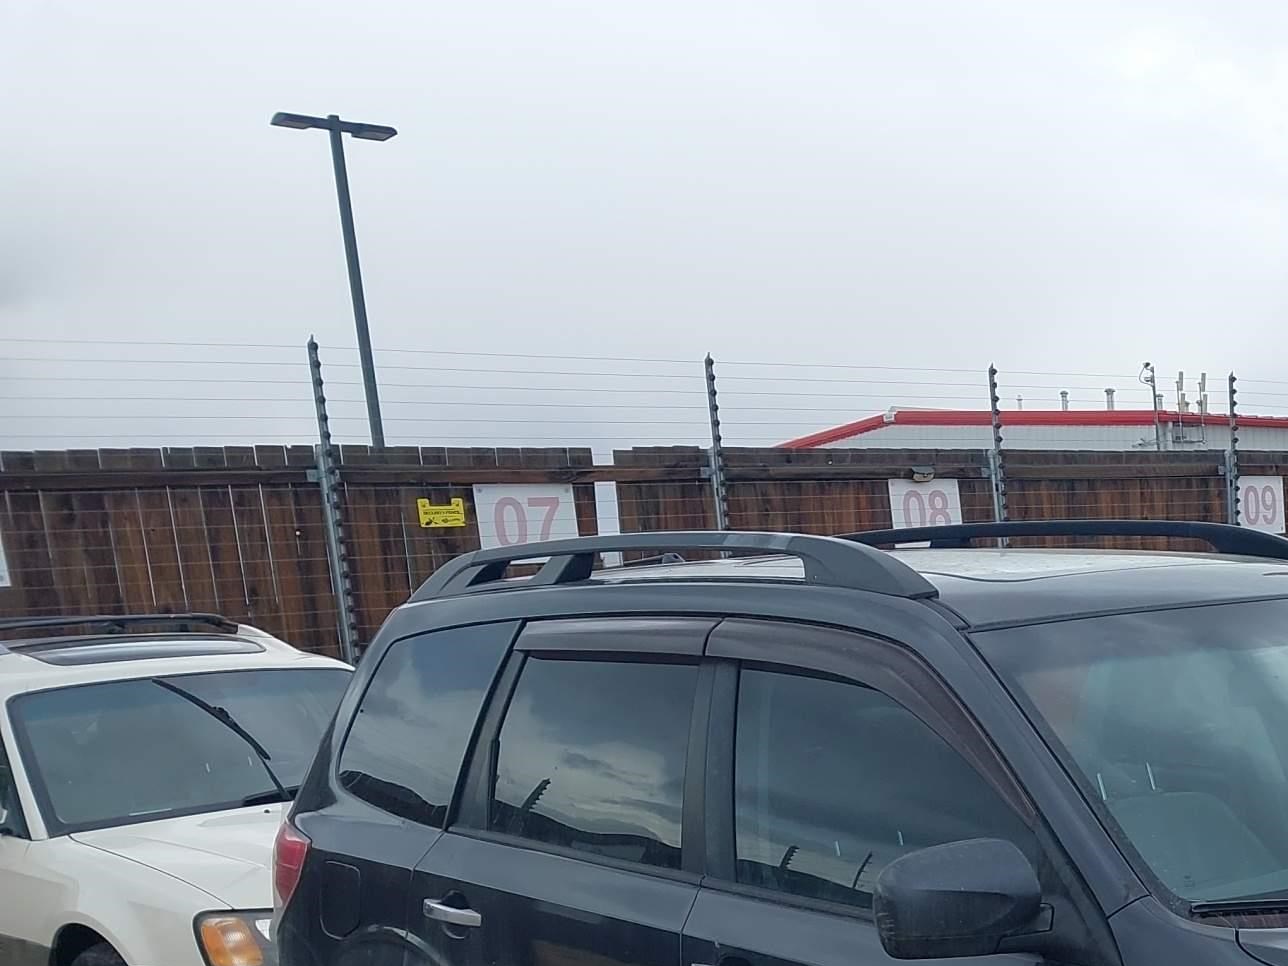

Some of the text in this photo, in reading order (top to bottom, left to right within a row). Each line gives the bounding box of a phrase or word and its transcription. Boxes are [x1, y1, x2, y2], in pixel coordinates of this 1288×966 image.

[494, 496, 559, 546] 07
[903, 489, 951, 527] 08
[1244, 485, 1276, 525] 09
